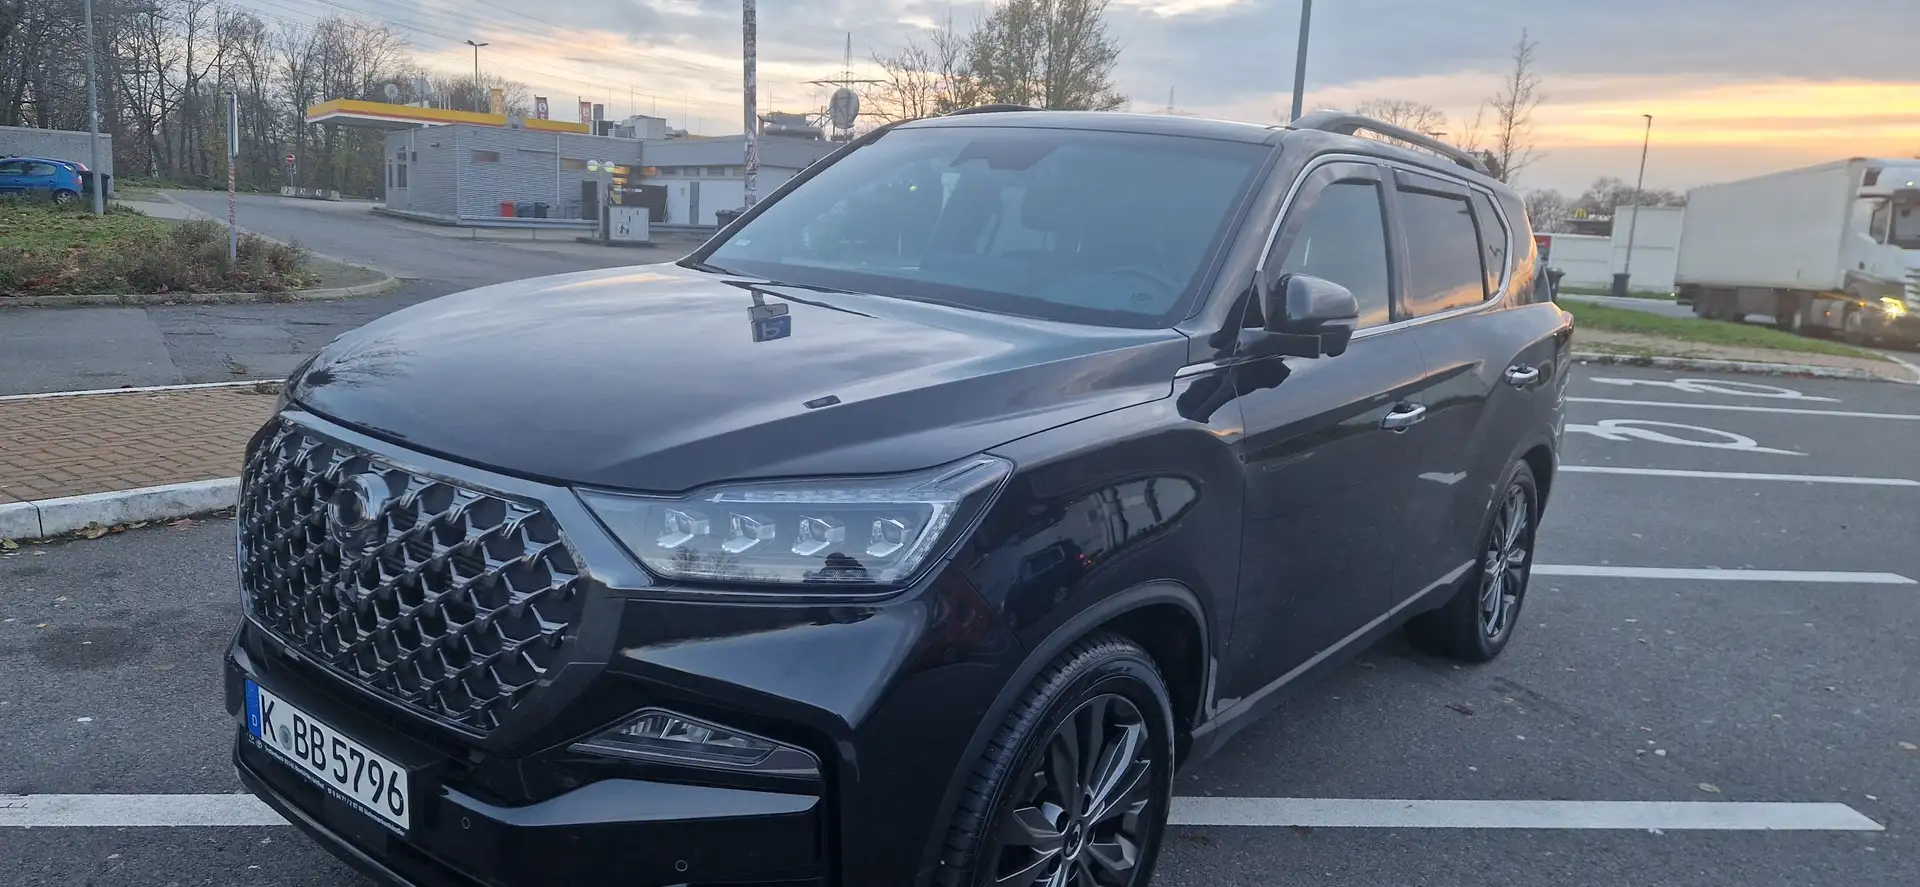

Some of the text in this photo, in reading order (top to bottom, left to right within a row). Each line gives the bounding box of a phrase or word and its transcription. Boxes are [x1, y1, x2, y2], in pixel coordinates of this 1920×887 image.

[251, 714, 258, 727] D
[261, 694, 277, 744] K
[293, 713, 326, 771] BB
[332, 736, 404, 817] 5796
